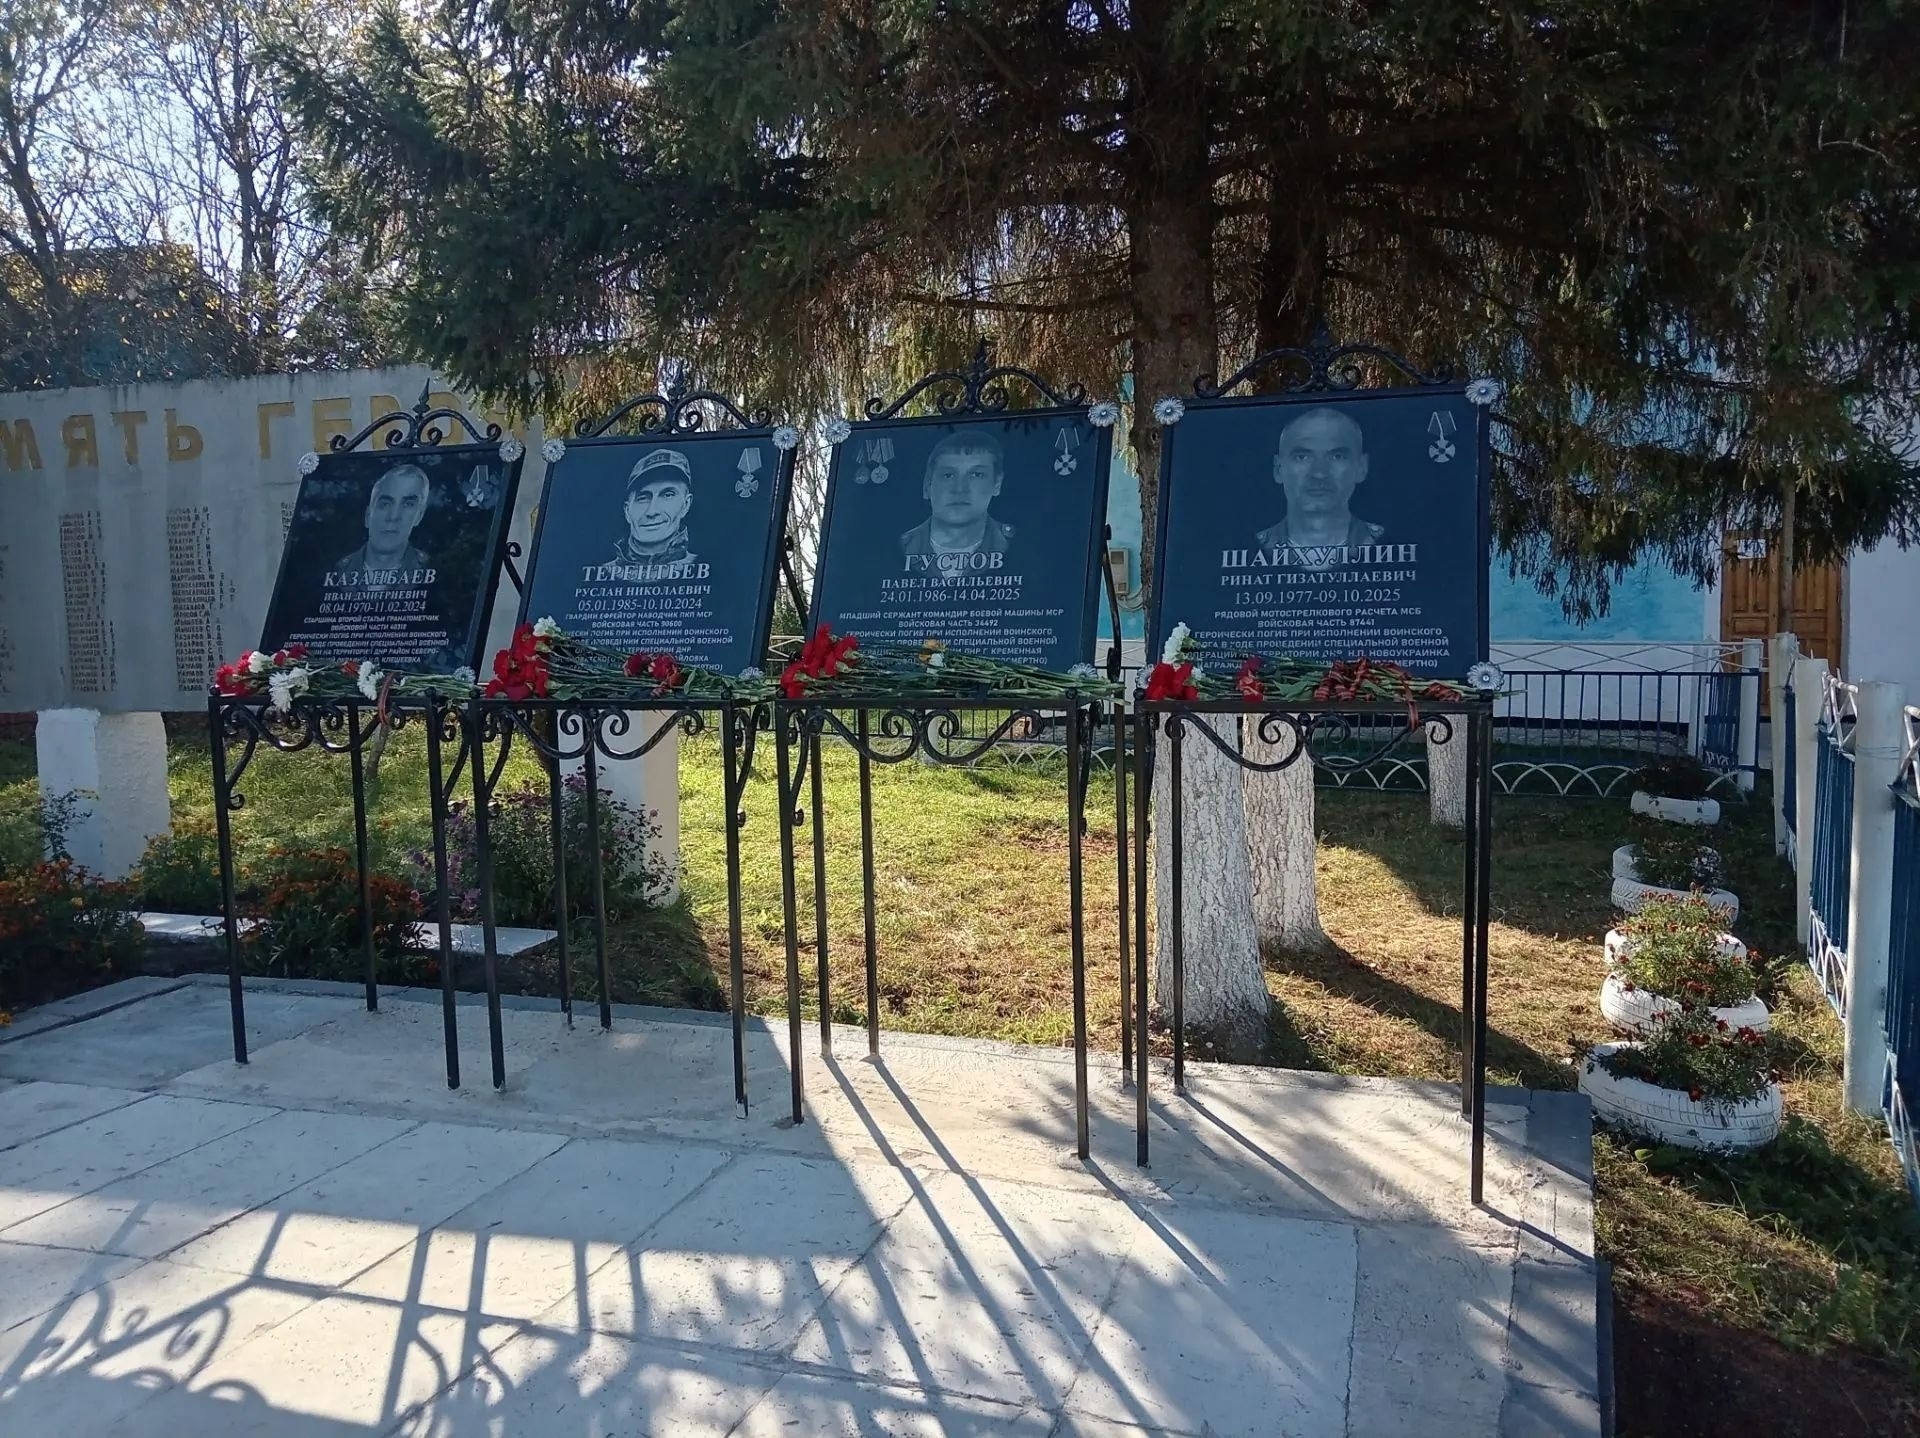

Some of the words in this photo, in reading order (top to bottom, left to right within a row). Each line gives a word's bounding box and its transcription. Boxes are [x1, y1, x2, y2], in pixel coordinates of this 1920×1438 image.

[257, 391, 527, 461] ГЕРО
[904, 551, 1005, 572] ГУСТОВ
[1220, 543, 1418, 568] ШАЙХУЛЛИН
[323, 569, 437, 587] КАЗАНБАЕВ
[582, 563, 711, 582] ТЕРЕНТЬЕВ
[1220, 574, 1273, 586] РИНАТ
[1276, 570, 1417, 585] ГИЗАТУЛЛАЕВИЧ
[881, 578, 926, 589] ПАВЕЛ
[930, 575, 1023, 588] ВАСИЛЬЕВИЧ
[324, 591, 352, 601] ИВАН
[353, 590, 428, 601] ДМИТРИЕВИЧ
[575, 587, 623, 597] РУСЛАН
[626, 585, 711, 596] НИКОЛАЕВИЧ
[880, 588, 1021, 603] 24.01.1986-14.04.2025
[1235, 588, 1401, 605] 13.09.1977-09.10.2025
[319, 601, 426, 614] 08.04.1970-11.02.2024
[578, 598, 702, 612] 05.01.1985-10.10.2024
[338, 615, 362, 623] ВТОРОЙ
[599, 611, 637, 620] ЕФРЕЙТОР
[637, 611, 678, 620] НАВОДЧИК
[839, 611, 881, 620] МЛАДШИЙ
[883, 611, 922, 619] СЕРЖАНТ
[922, 610, 969, 619] КОМАНДИР
[969, 608, 1003, 617] БОЕВОЙ
[1004, 608, 1044, 617] МАШИНЫ
[1045, 608, 1065, 616] МСР
[1214, 608, 1259, 619] РЯДОВОЙ
[1260, 608, 1353, 618] МОТОСТРЕЛКОВОГО
[1354, 607, 1399, 616] РАСЧЕТА
[1400, 607, 1422, 616] МСБ
[330, 623, 367, 631] ВОЙСКОВОЙ
[592, 619, 636, 628] ВОЙСКОВАЯ
[636, 620, 660, 628] ЧАСТЬ
[898, 618, 946, 628] ВОЙСКОВАЯ
[947, 619, 973, 628] ЧАСТЬ
[974, 618, 999, 627] 34492
[1257, 618, 1314, 628] ВОЙСКОВАЯ
[1315, 618, 1347, 627] ЧАСТЬ
[365, 631, 409, 639] ИСПОЛНЕНИИ
[615, 629, 631, 637] ПРИ
[684, 627, 729, 635] ВОИНСКОГО
[897, 629, 924, 637] ПОГИБ
[926, 628, 943, 637] ПРИ
[944, 628, 1001, 637] ИСПОЛНЕНИИ
[1003, 627, 1053, 636] ВОИНСКОГО
[1194, 630, 1255, 639] ГЕРОИЧЕСКИ
[1257, 629, 1288, 638] ПОГИБ
[1290, 629, 1311, 637] ПРИ
[1313, 628, 1381, 638] ИСПОЛНЕНИИ
[1383, 627, 1442, 636] ВОИНСКОГО
[370, 638, 418, 647] СПЕЦИАЛЬНОЙ
[418, 638, 449, 646] ВОЕННОЙ
[640, 636, 696, 645] СПЕЦИАЛЬНОЙ
[697, 635, 733, 644] ВОЕННОЙ
[953, 636, 1016, 647] СПЕЦИАЛЬНОЙ
[1017, 635, 1058, 645] ВОЕННОЙ
[1324, 637, 1399, 648] СПЕЦИАЛЬНОЙ
[1401, 636, 1449, 647] ВОЕННОЙ
[675, 646, 692, 654] ДНР
[990, 647, 1043, 655] КРЕМЕННАЯ
[1368, 648, 1450, 658] НОВОУКРАИНКА
